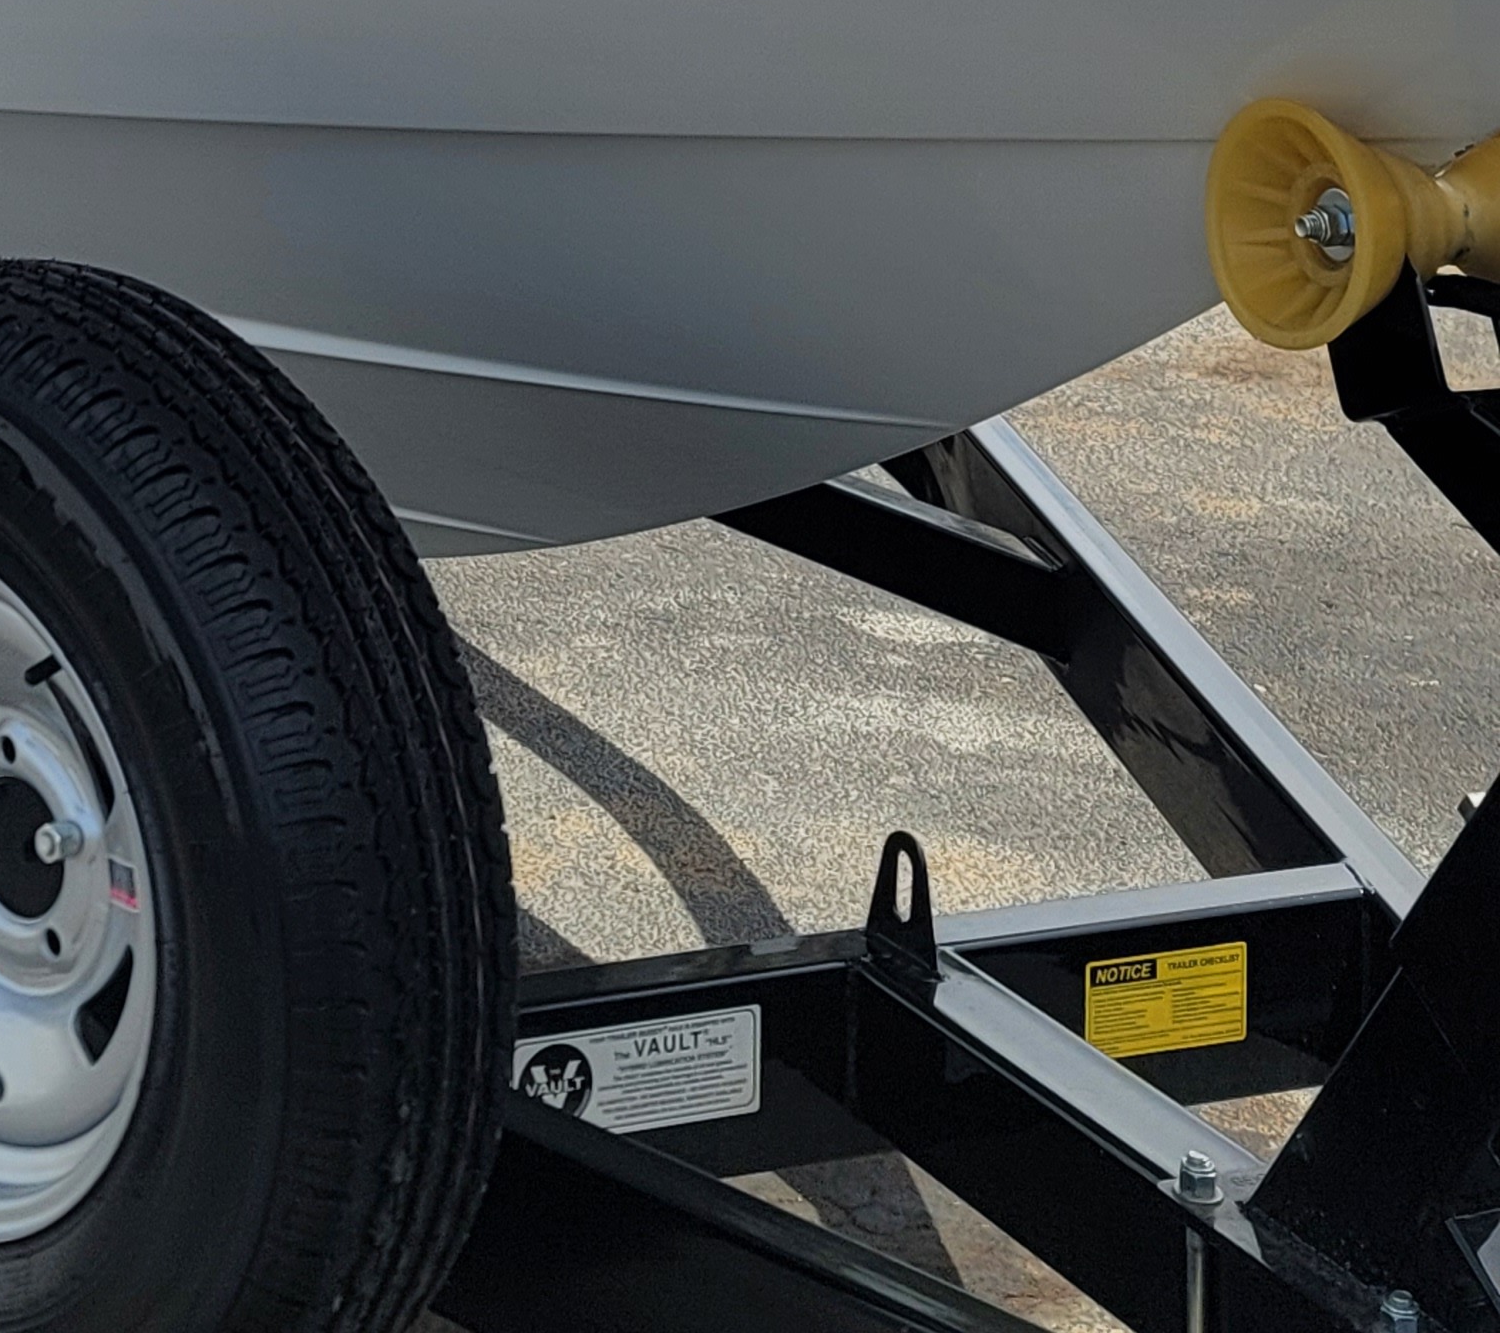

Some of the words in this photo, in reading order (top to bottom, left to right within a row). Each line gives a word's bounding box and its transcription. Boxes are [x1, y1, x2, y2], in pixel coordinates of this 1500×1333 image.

[1095, 963, 1153, 984] NOTICE
[634, 1031, 702, 1058] VAULT
[525, 1075, 586, 1098] VAULT
